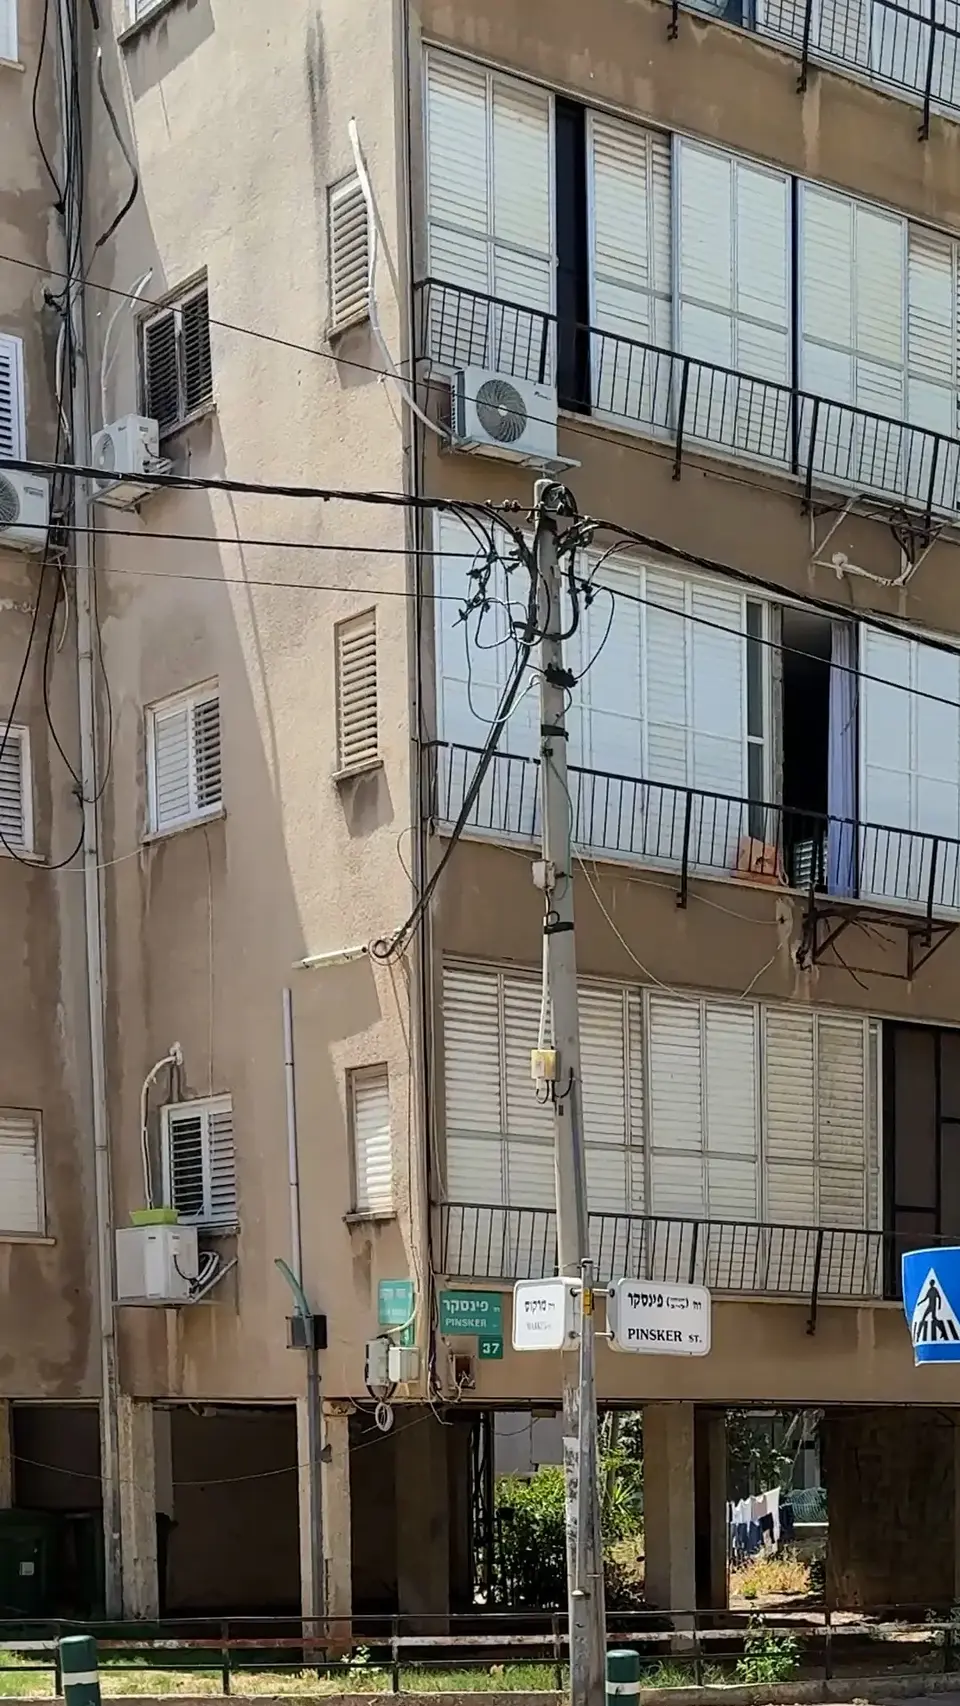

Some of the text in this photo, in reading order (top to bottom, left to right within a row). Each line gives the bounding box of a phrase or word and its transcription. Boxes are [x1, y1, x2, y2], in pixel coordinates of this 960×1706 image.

[442, 1299, 489, 1314] פינסקר
[627, 1292, 664, 1309] פינסקר
[445, 1318, 487, 1328] PINSKER
[627, 1328, 683, 1342] PINSKER
[482, 1343, 500, 1354] 37
